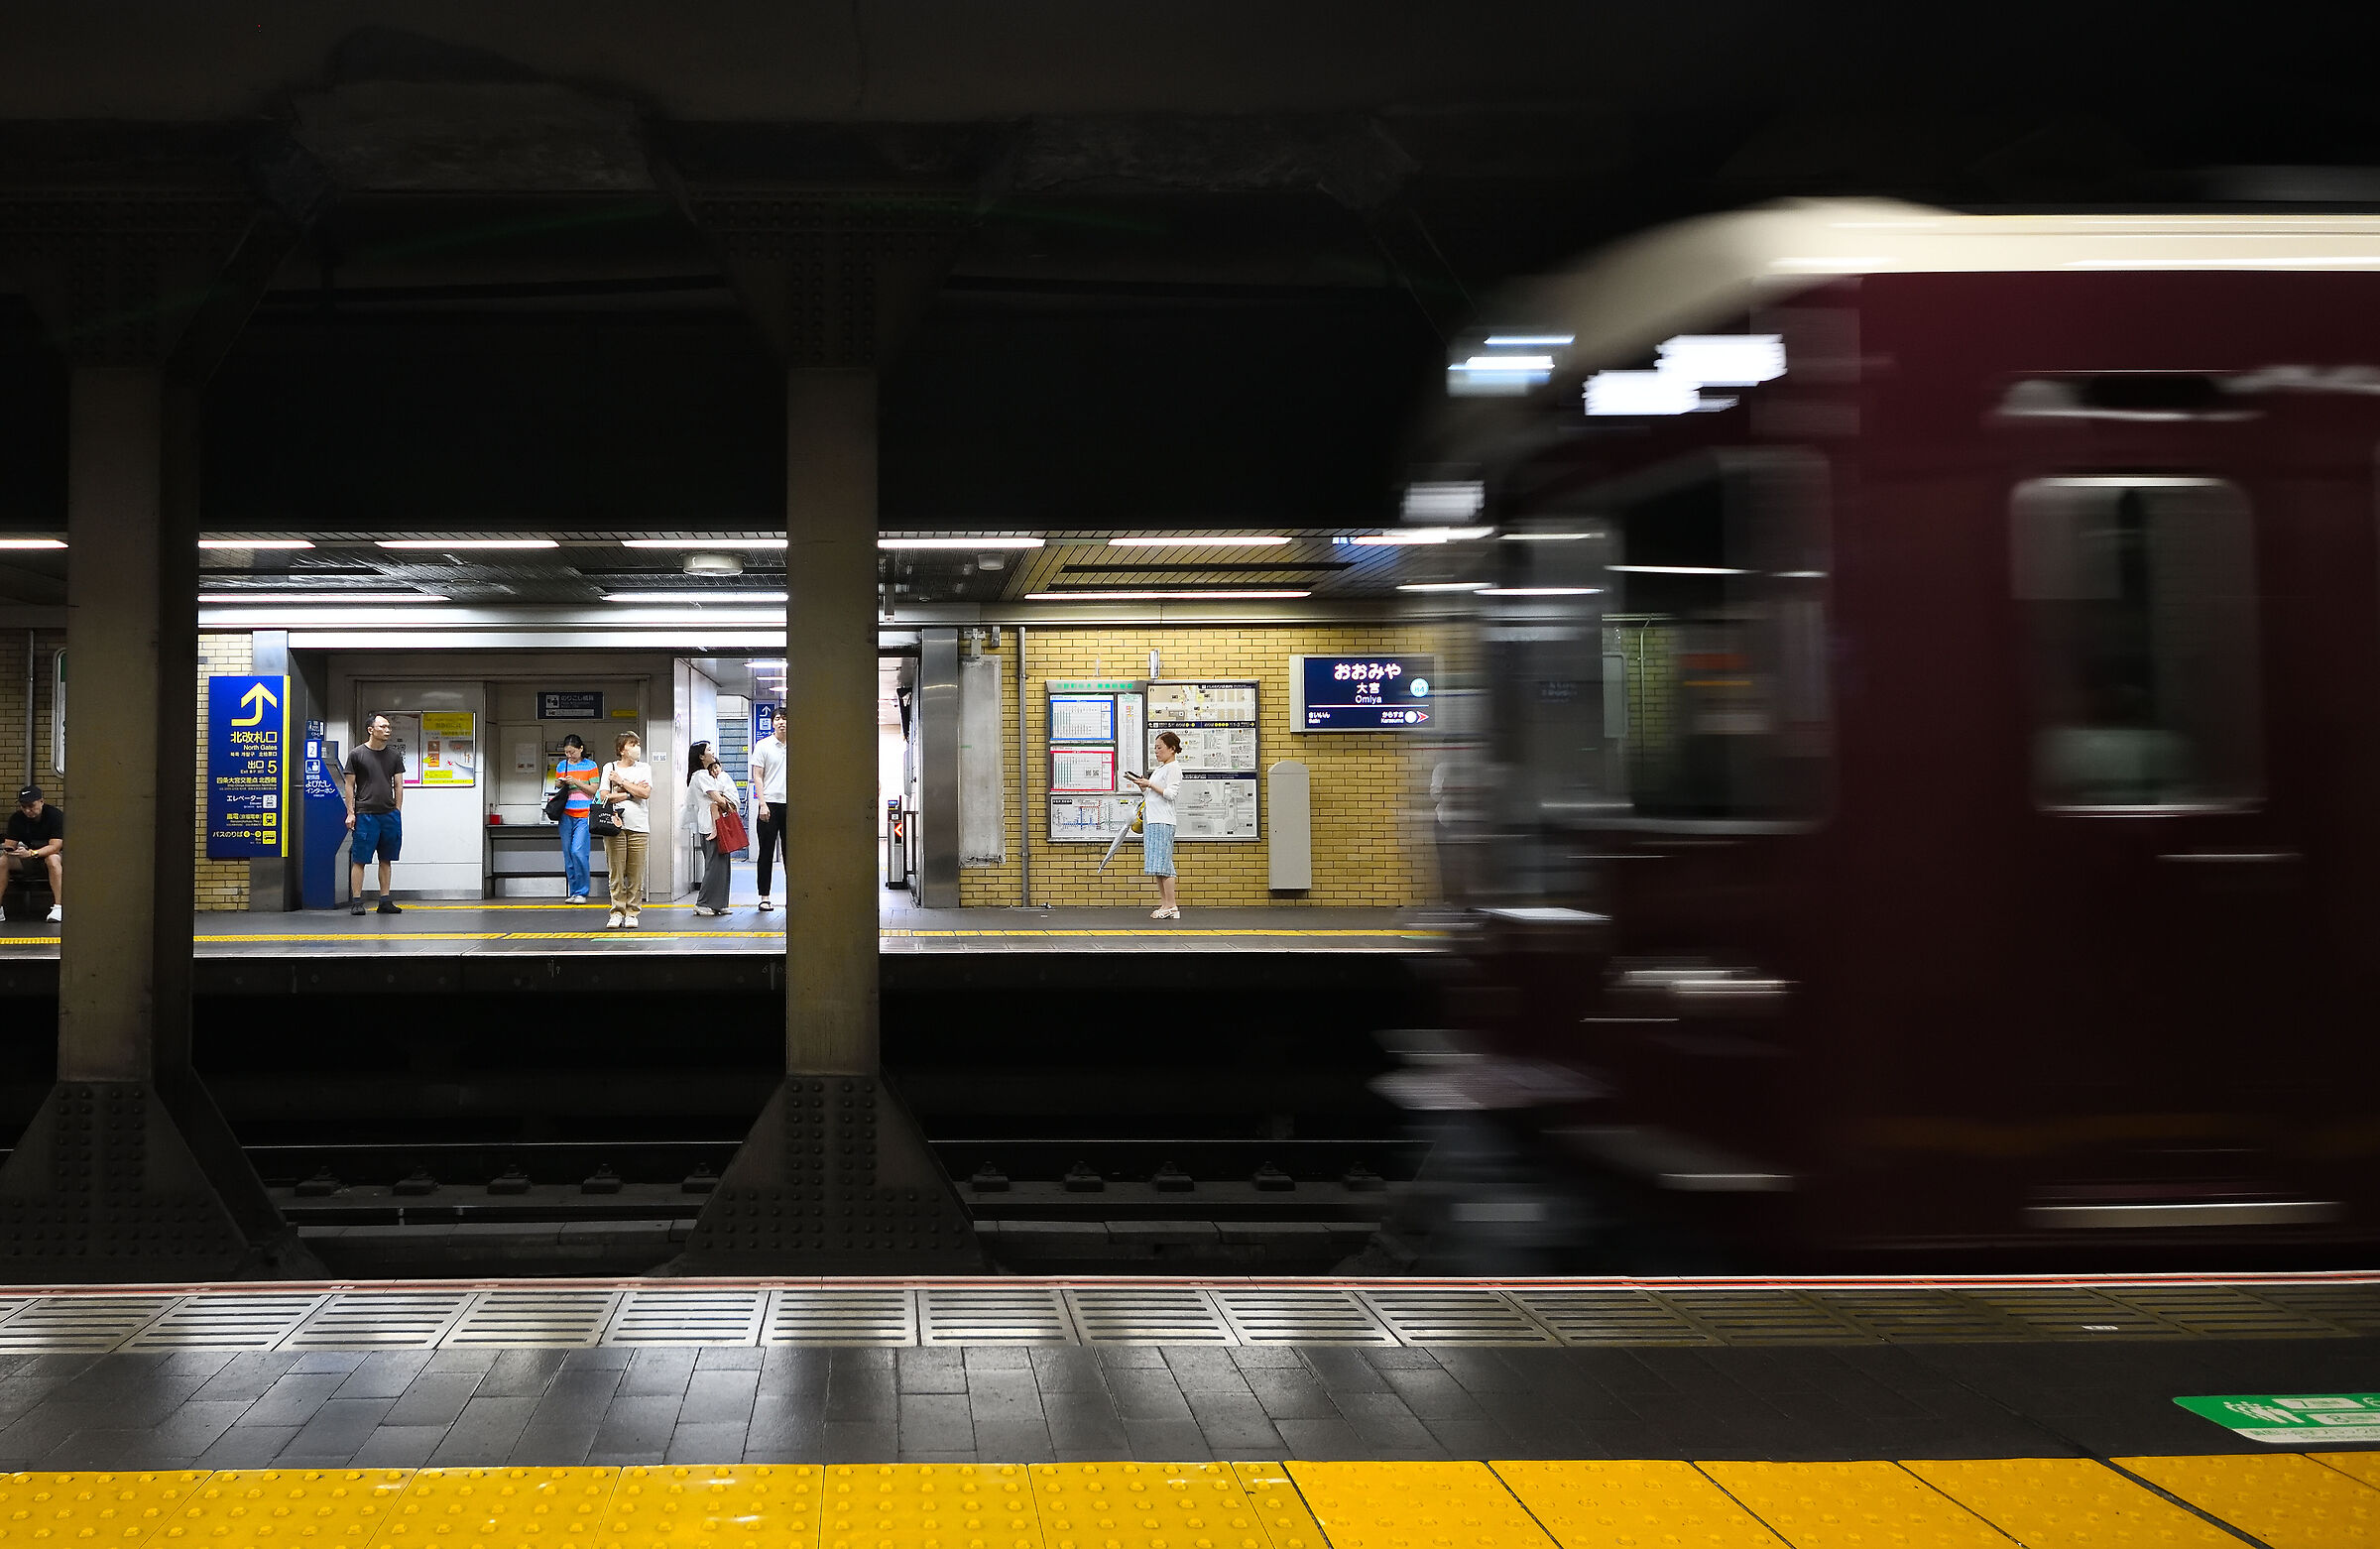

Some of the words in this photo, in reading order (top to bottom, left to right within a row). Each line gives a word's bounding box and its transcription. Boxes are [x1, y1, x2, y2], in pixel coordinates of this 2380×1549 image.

[1334, 662, 1402, 680] おおみや
[1356, 681, 1380, 694] 大宮
[1355, 695, 1382, 705] Omiya
[230, 731, 278, 744] 北改札口
[309, 746, 315, 756] 2
[247, 761, 265, 770] 出口
[267, 760, 278, 774] 5
[305, 779, 332, 788] よびだし
